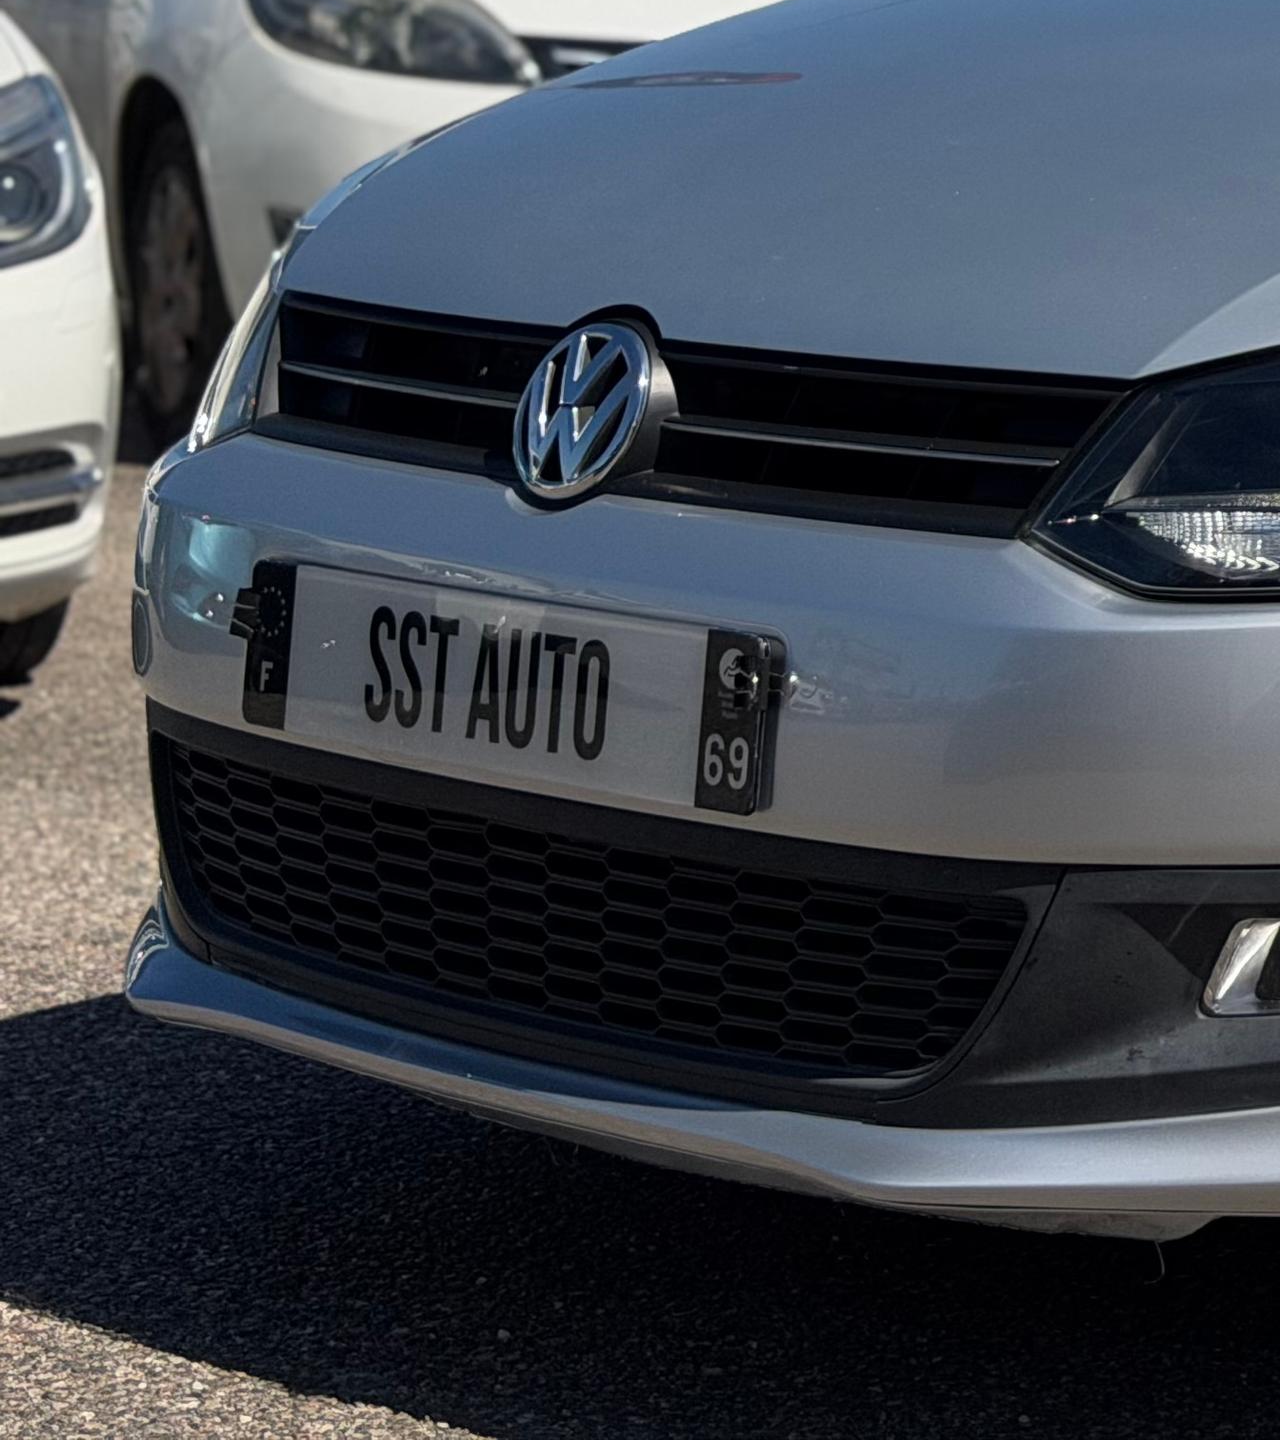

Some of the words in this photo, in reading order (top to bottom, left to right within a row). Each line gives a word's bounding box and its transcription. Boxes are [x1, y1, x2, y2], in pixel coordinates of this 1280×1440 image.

[259, 661, 275, 692] F
[363, 605, 460, 733] SST
[464, 623, 611, 761] AUTO
[703, 732, 750, 790] 69
